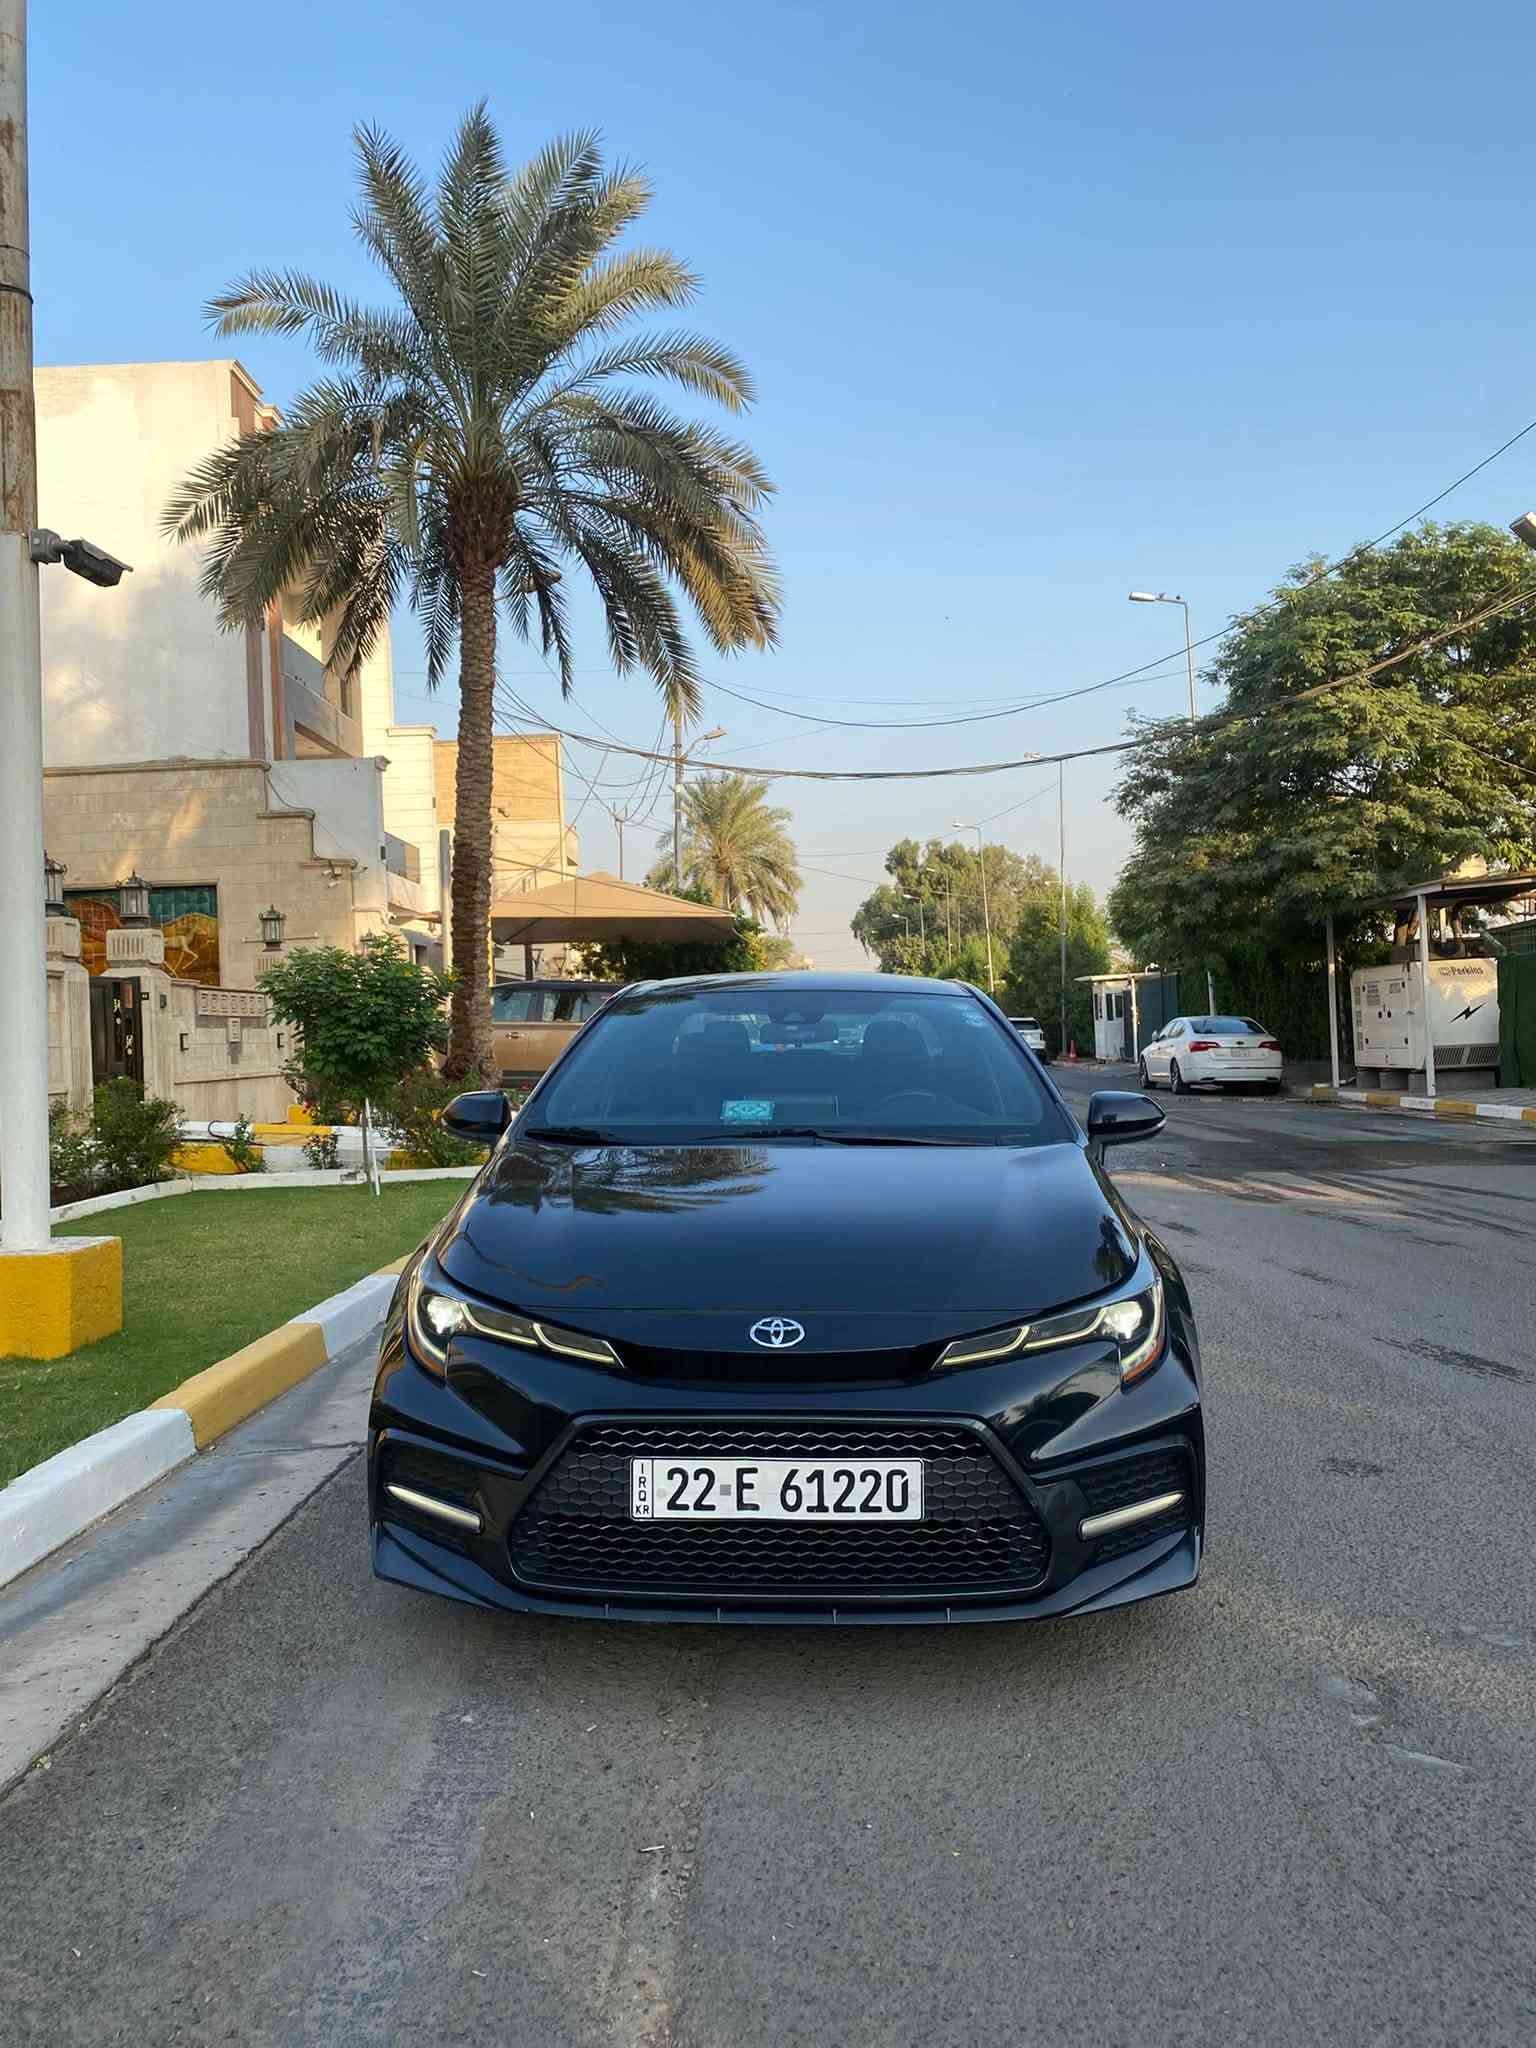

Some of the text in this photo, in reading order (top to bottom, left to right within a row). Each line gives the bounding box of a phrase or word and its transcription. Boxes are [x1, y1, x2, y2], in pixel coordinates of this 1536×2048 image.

[667, 1467, 909, 1513] 22 E 61220
